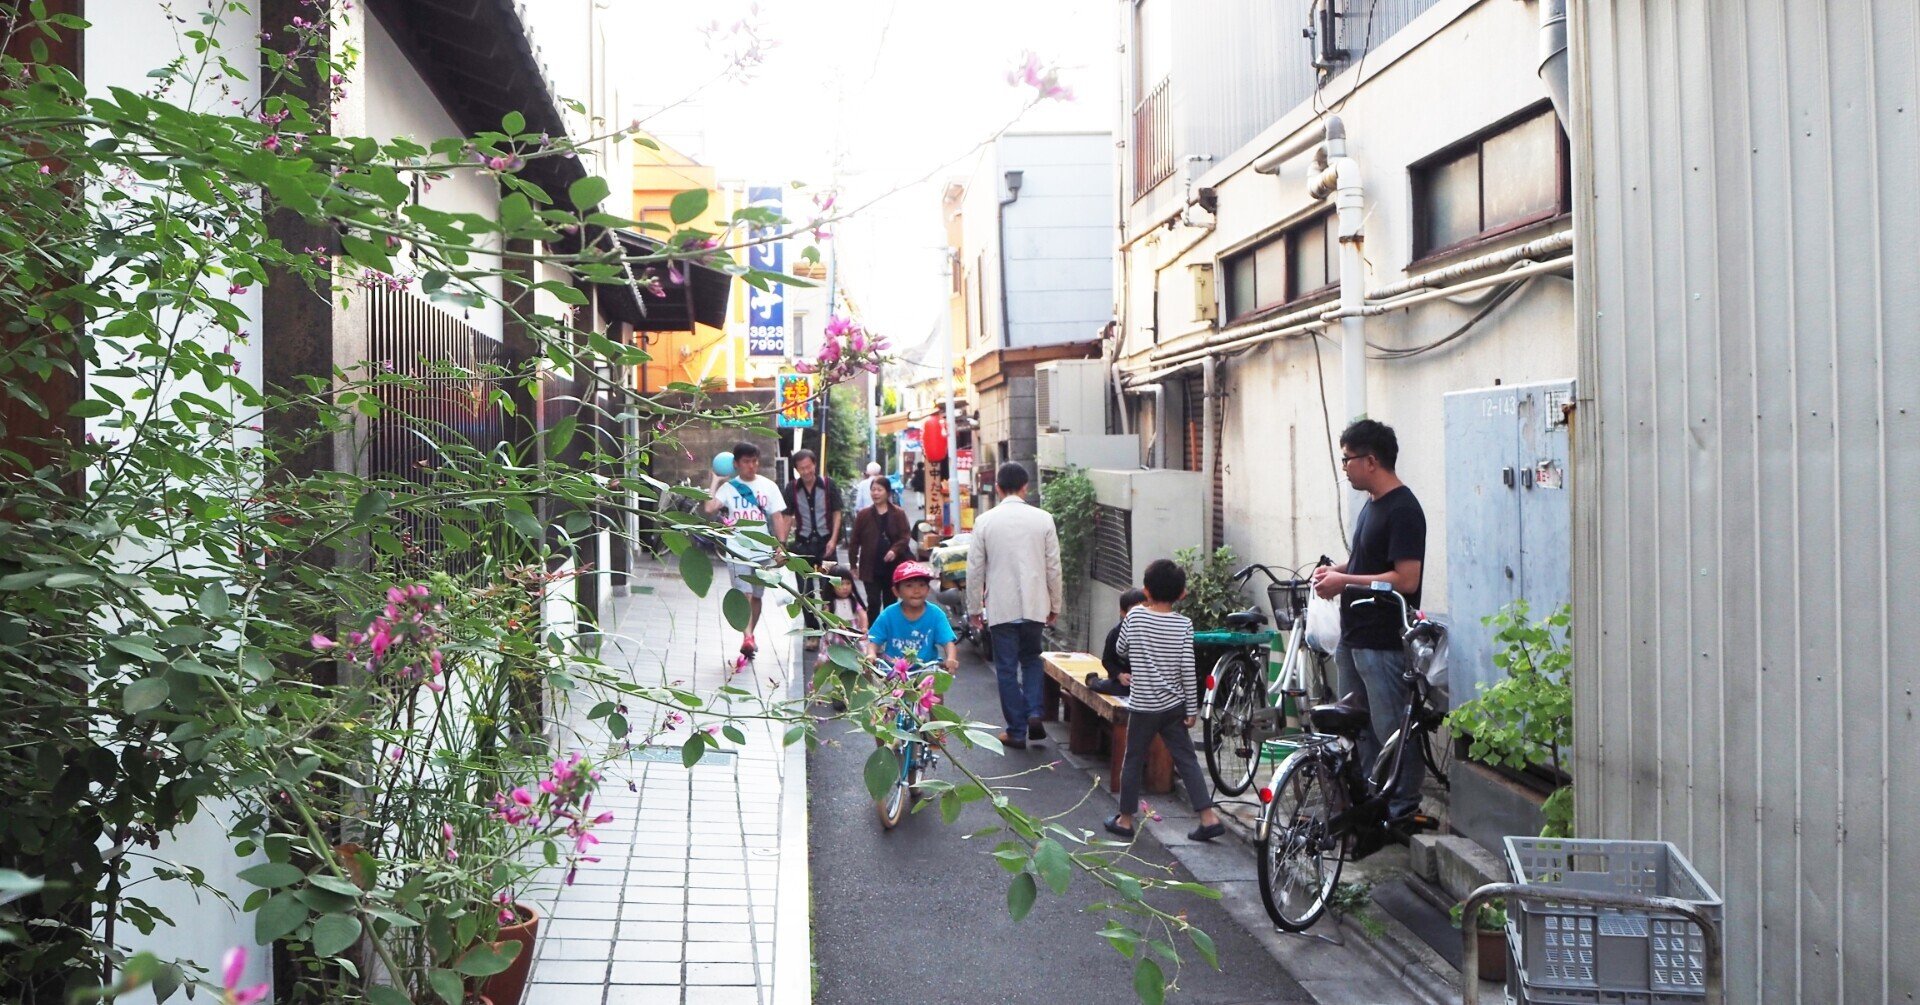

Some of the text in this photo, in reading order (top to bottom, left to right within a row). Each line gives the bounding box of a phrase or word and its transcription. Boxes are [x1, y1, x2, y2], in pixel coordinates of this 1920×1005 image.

[749, 325, 784, 338] 3823
[750, 338, 784, 351] 7990
[1482, 395, 1516, 417] 12-143
